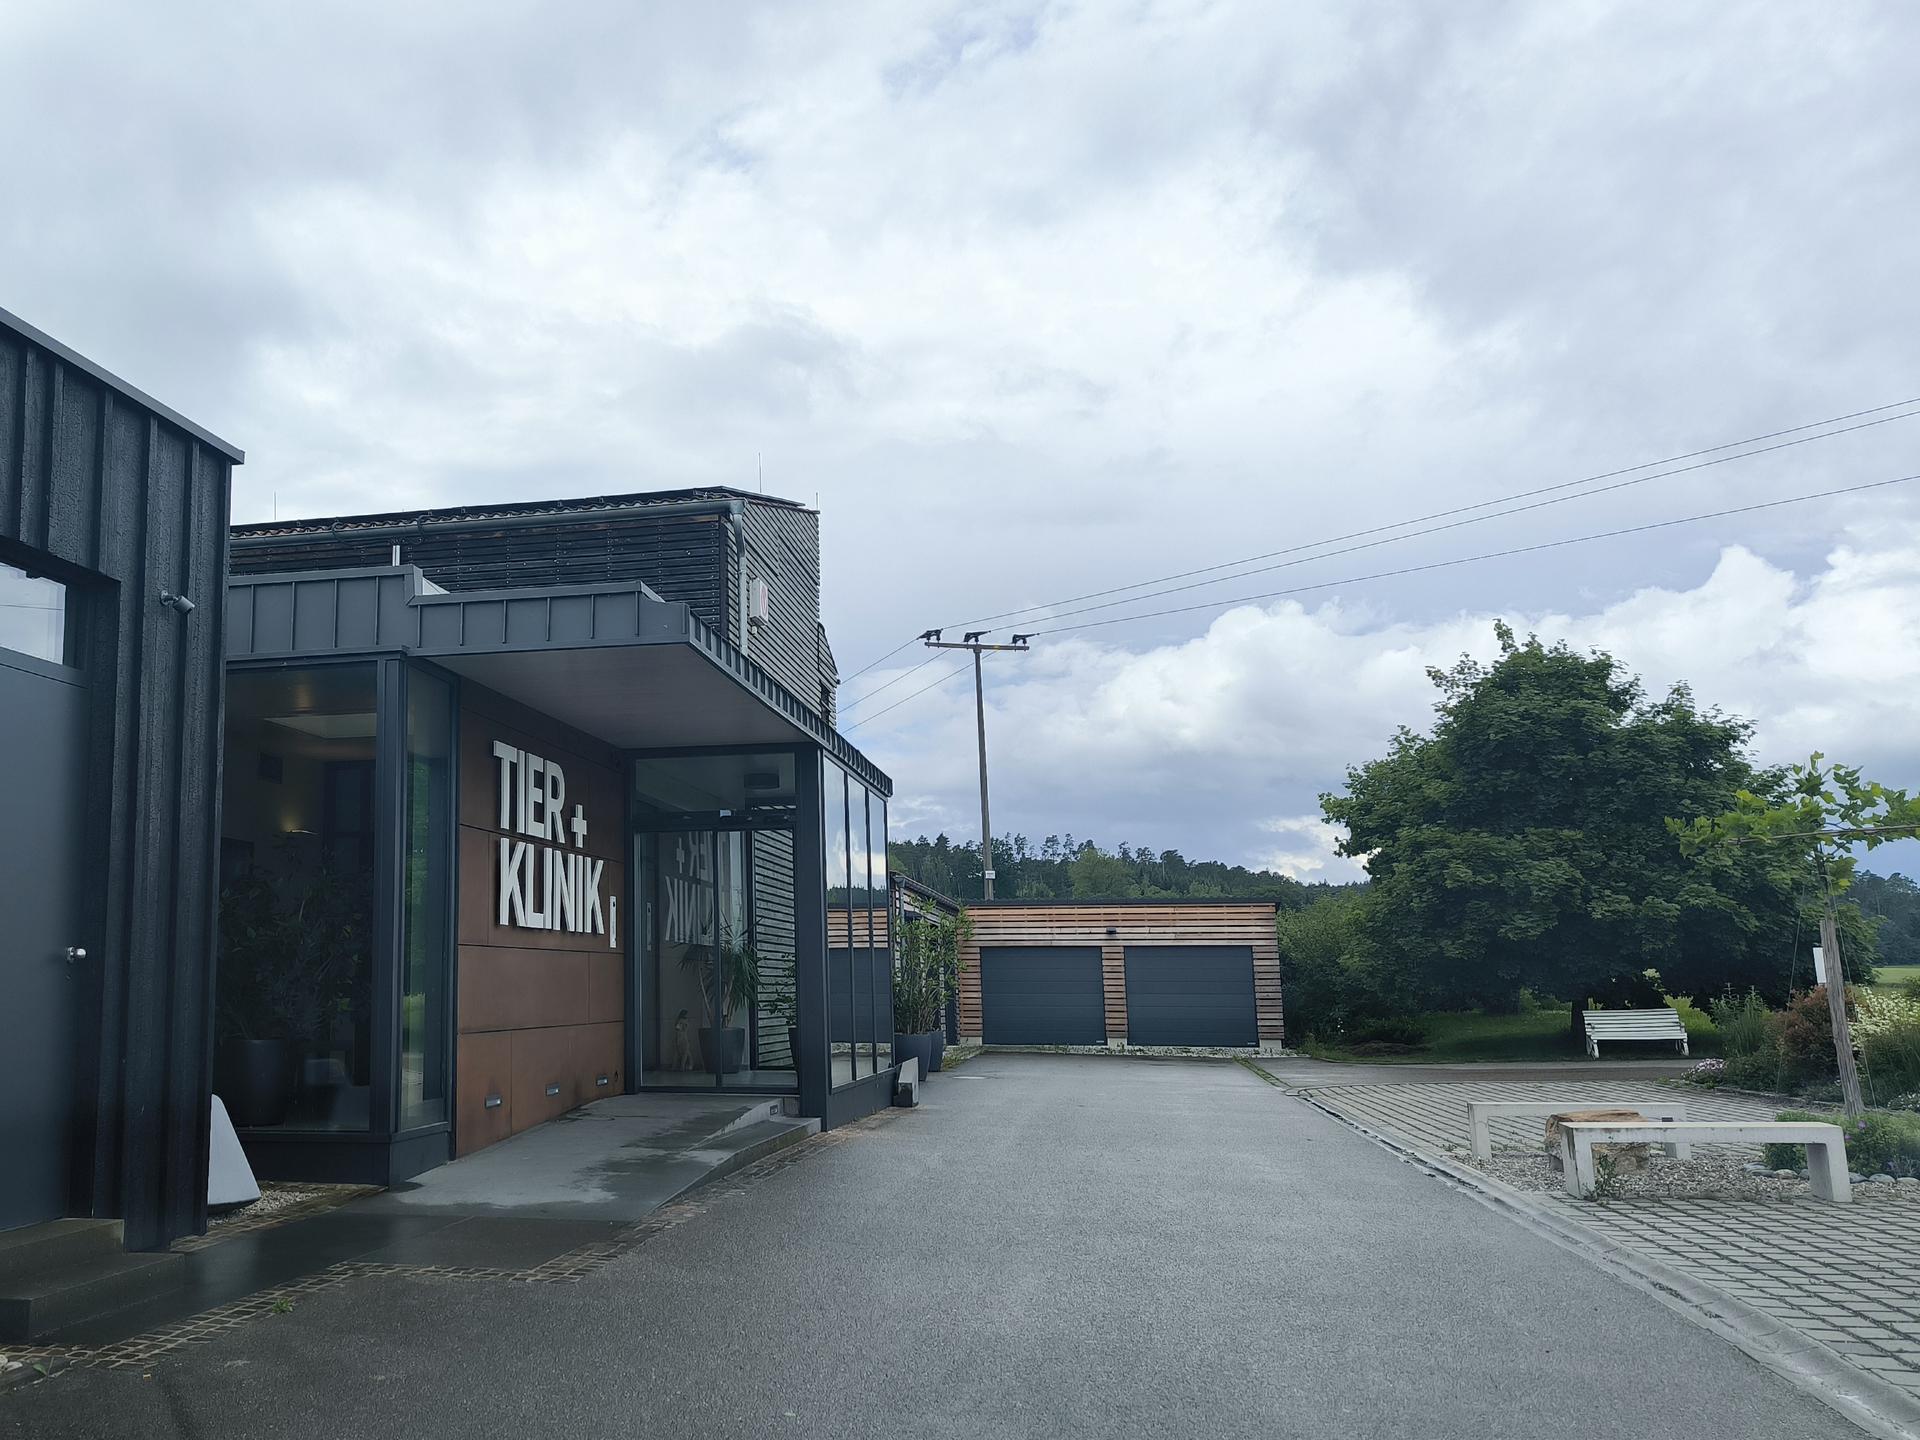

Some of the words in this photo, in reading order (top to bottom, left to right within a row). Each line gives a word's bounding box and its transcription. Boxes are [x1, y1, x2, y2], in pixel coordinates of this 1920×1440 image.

[494, 740, 566, 844] TIER
[570, 804, 588, 848] +
[500, 837, 605, 935] KLINIK
